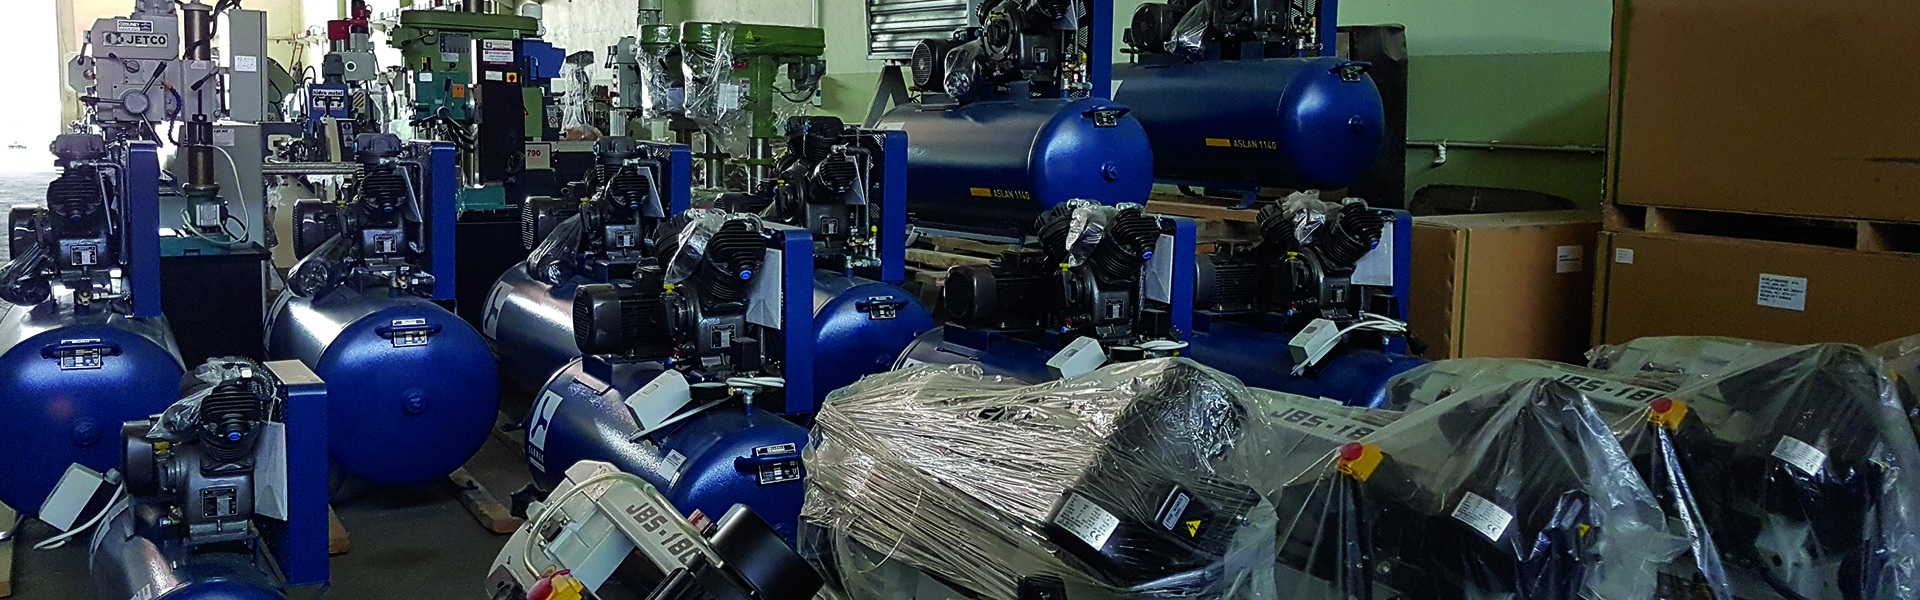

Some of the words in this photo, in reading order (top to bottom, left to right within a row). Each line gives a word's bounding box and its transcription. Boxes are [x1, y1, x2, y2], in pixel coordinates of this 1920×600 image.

[126, 35, 166, 45] JETCO
[1233, 139, 1258, 149] ASLAN
[1259, 140, 1277, 151] 1140
[527, 149, 541, 157] 790
[993, 189, 1014, 199] ASLAN
[1014, 190, 1030, 200] 1140
